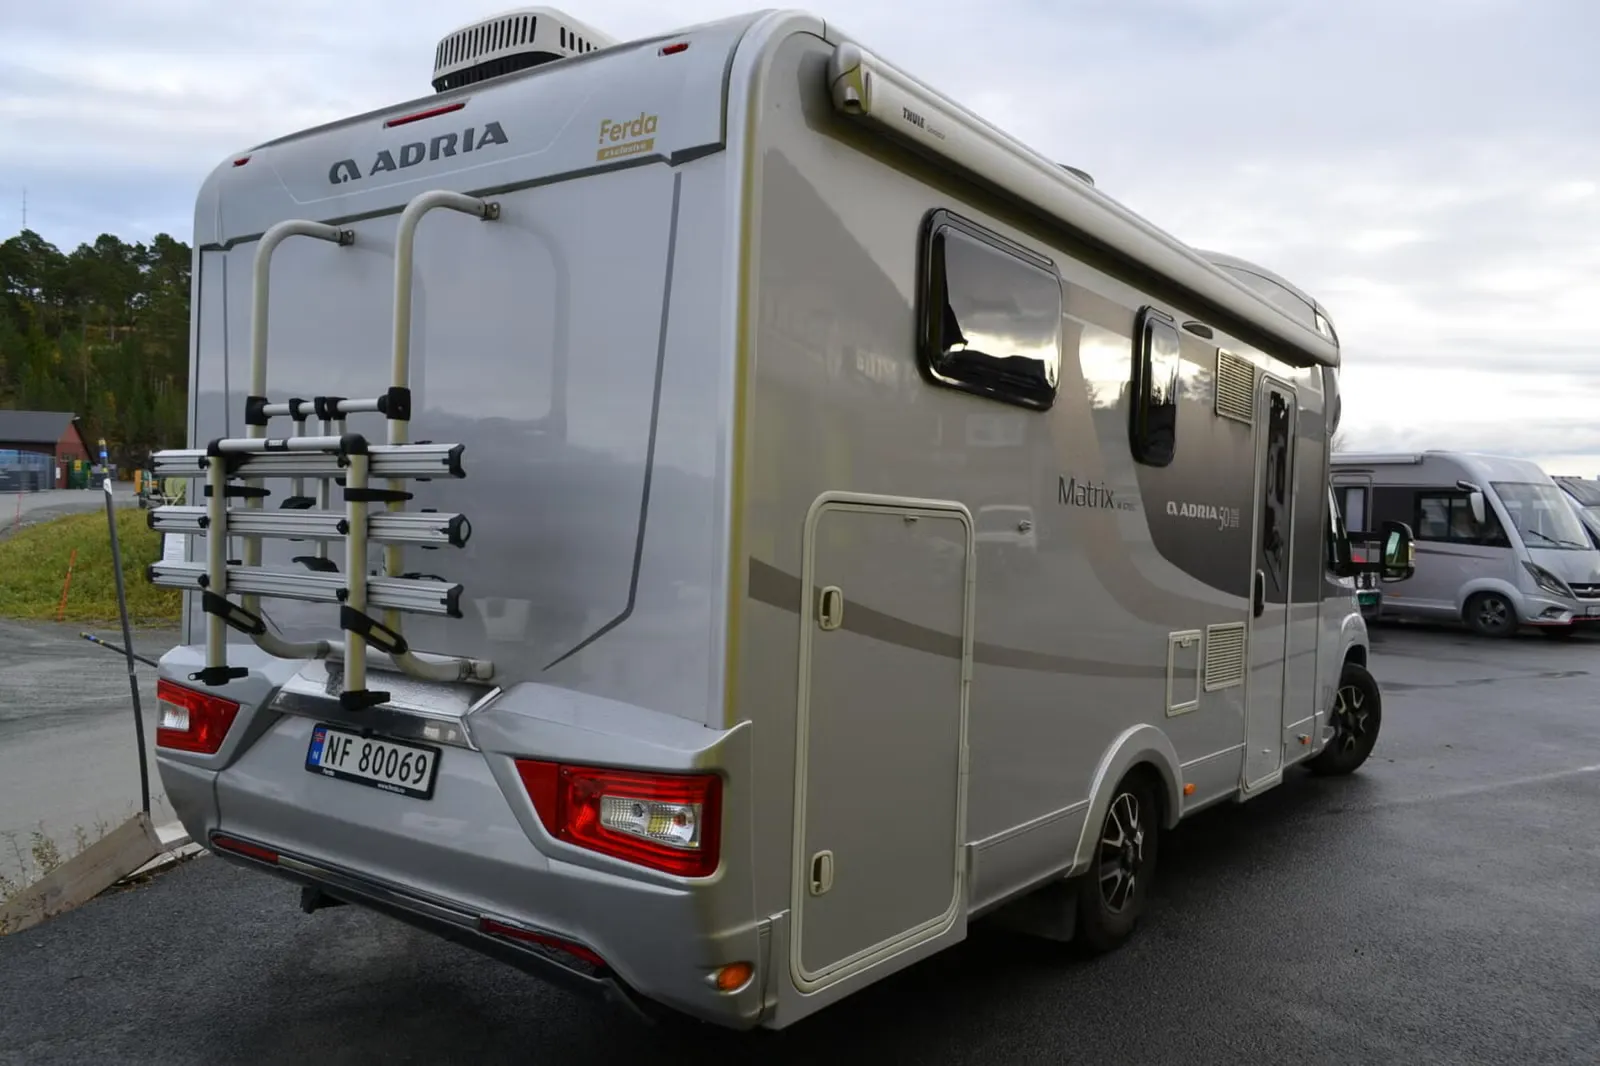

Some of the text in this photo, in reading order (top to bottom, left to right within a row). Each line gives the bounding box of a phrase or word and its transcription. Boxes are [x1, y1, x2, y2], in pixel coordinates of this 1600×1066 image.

[599, 112, 658, 144] Ferda
[903, 106, 925, 129] THULE
[369, 121, 509, 176] ADRIA
[1058, 475, 1114, 508] Matrix
[1179, 502, 1218, 520] ADRIA
[324, 735, 428, 785] NF 80069
